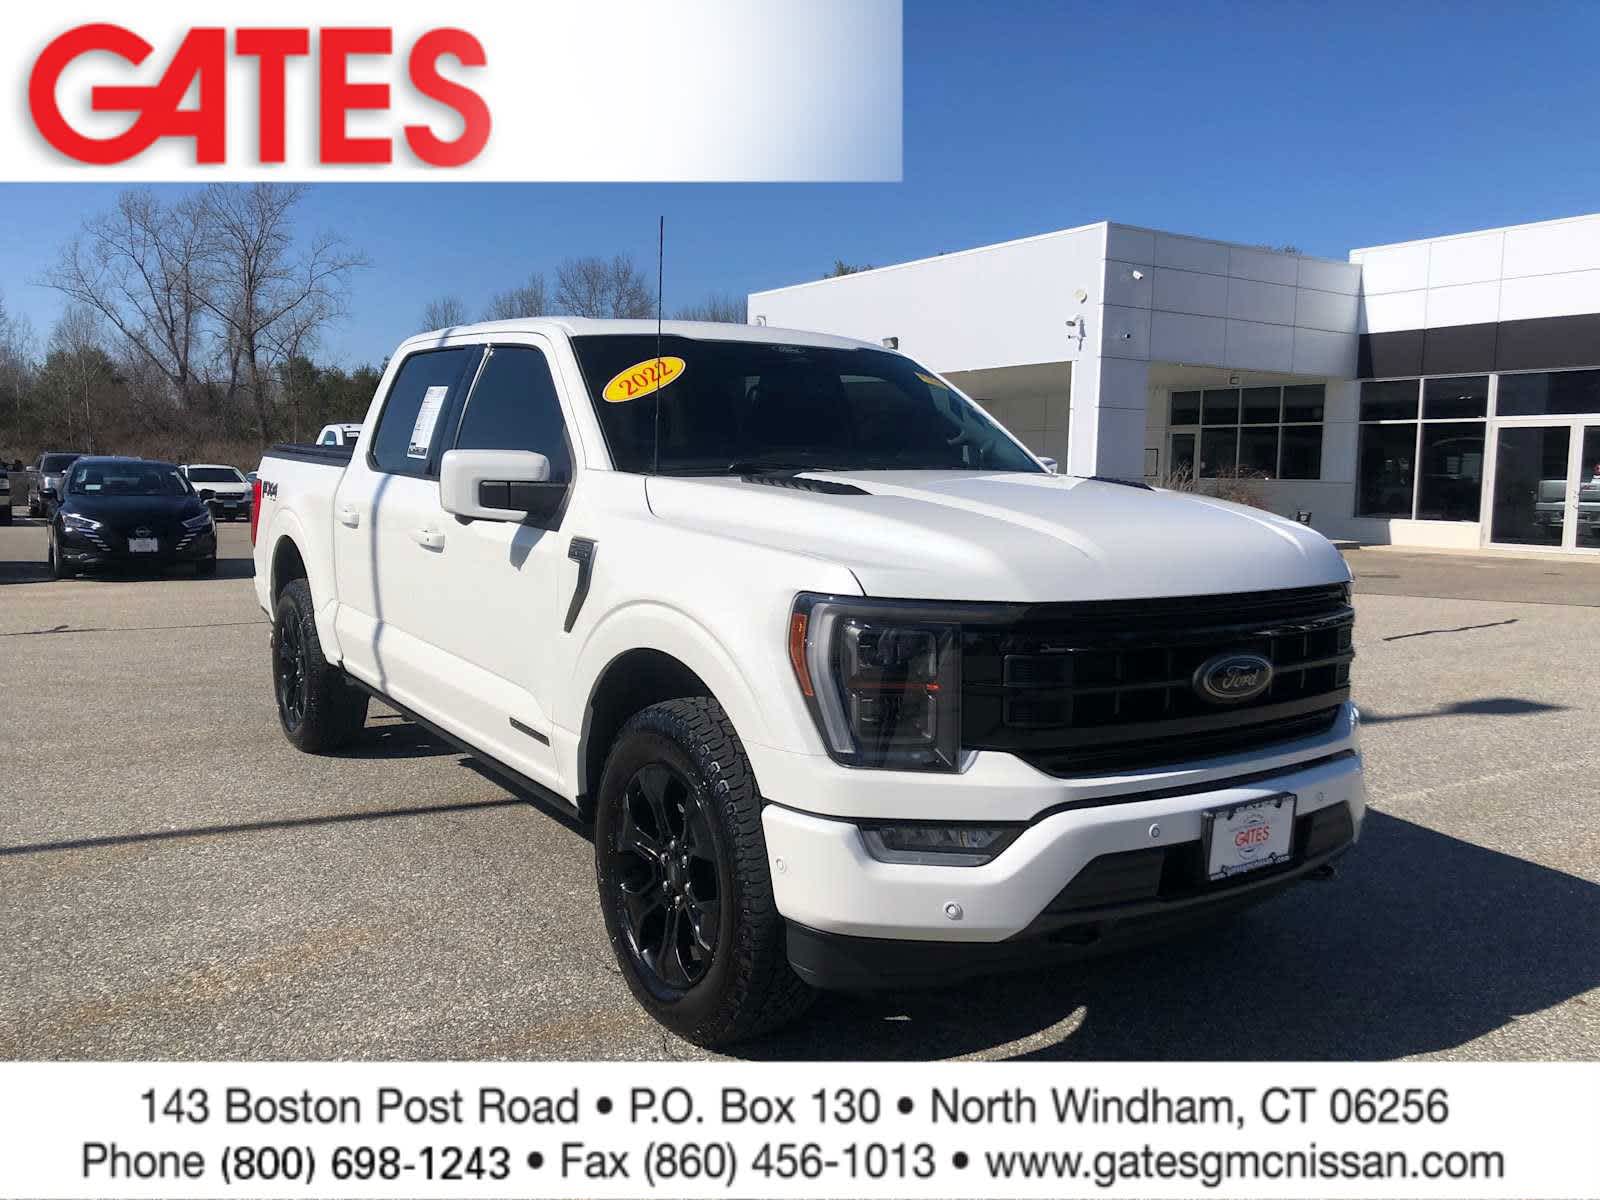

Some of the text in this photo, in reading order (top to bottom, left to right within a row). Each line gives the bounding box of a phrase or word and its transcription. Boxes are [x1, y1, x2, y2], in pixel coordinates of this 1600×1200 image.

[618, 361, 673, 396] 2022
[1222, 665, 1260, 689] Ford
[1234, 825, 1270, 847] GATES
